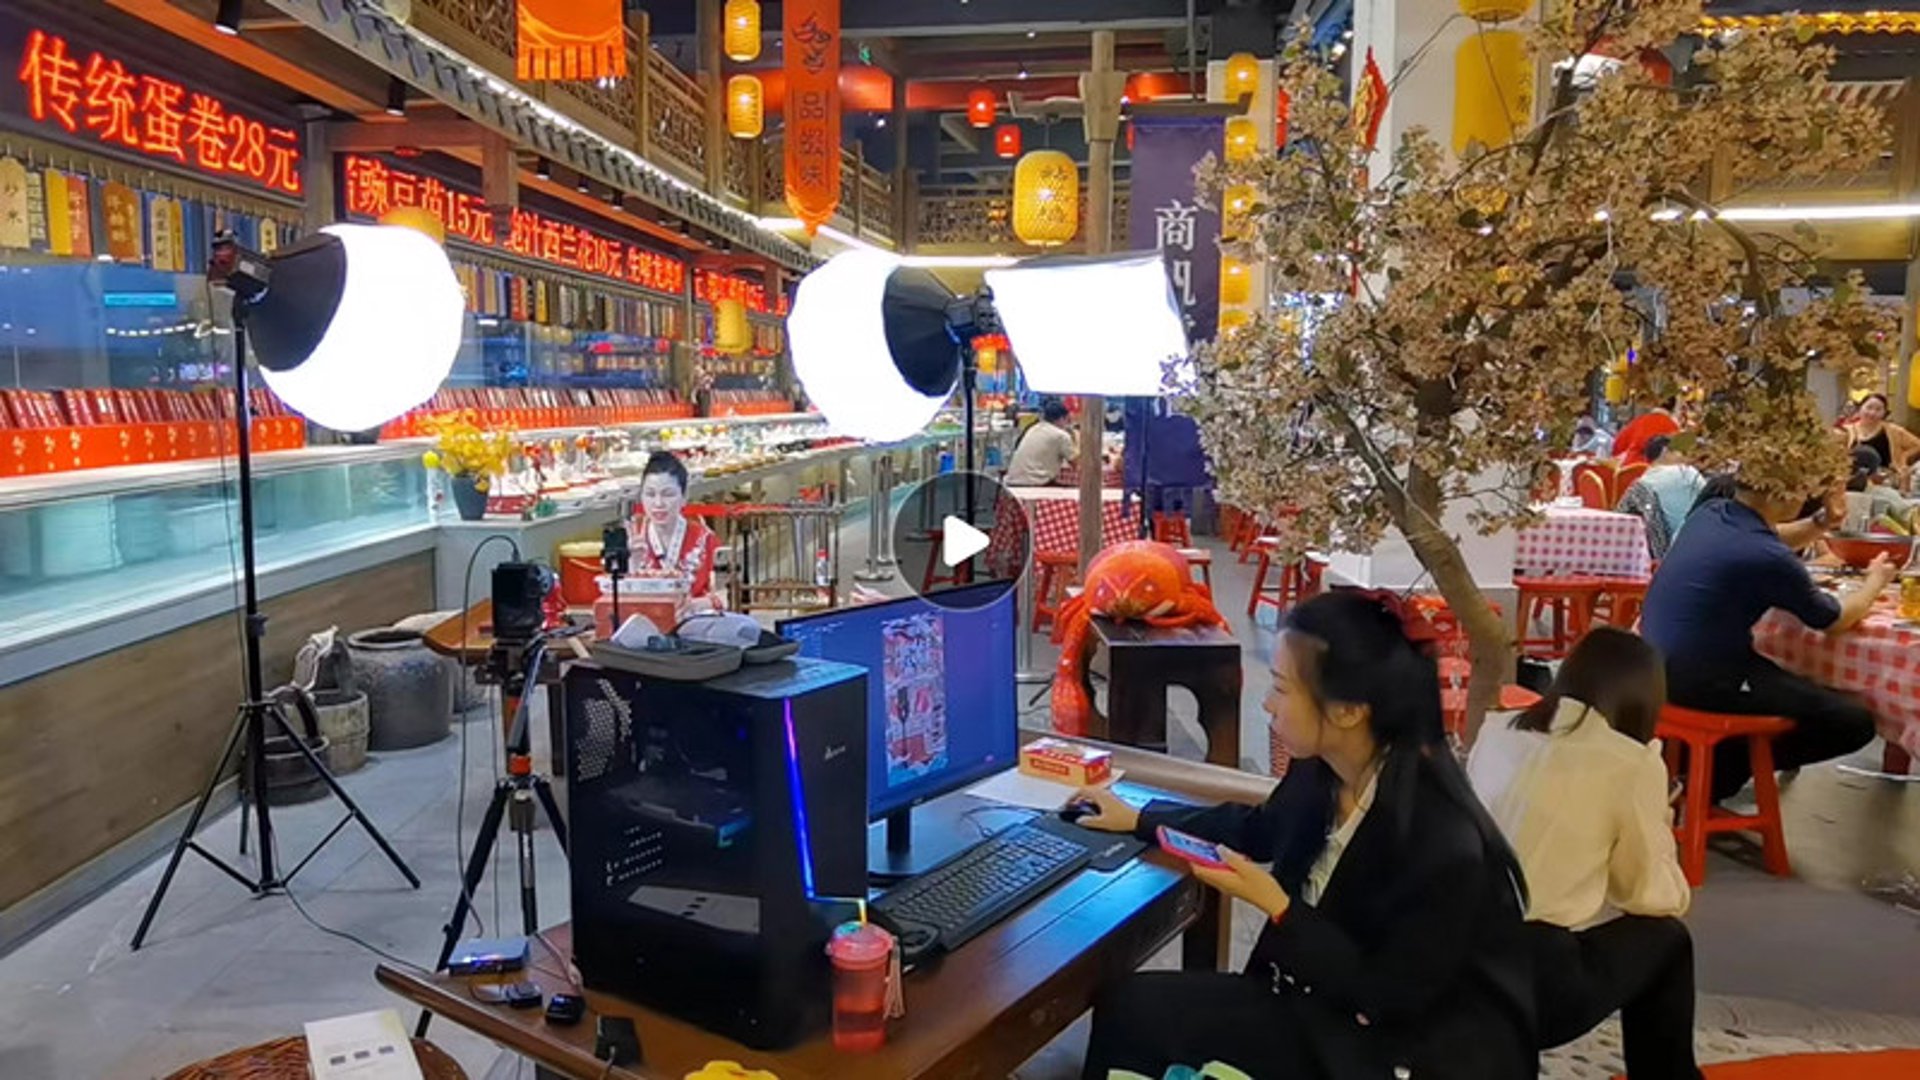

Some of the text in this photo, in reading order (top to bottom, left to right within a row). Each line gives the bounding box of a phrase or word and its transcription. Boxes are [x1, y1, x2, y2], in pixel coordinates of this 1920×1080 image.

[19, 28, 300, 193] 传统蛋卷28元
